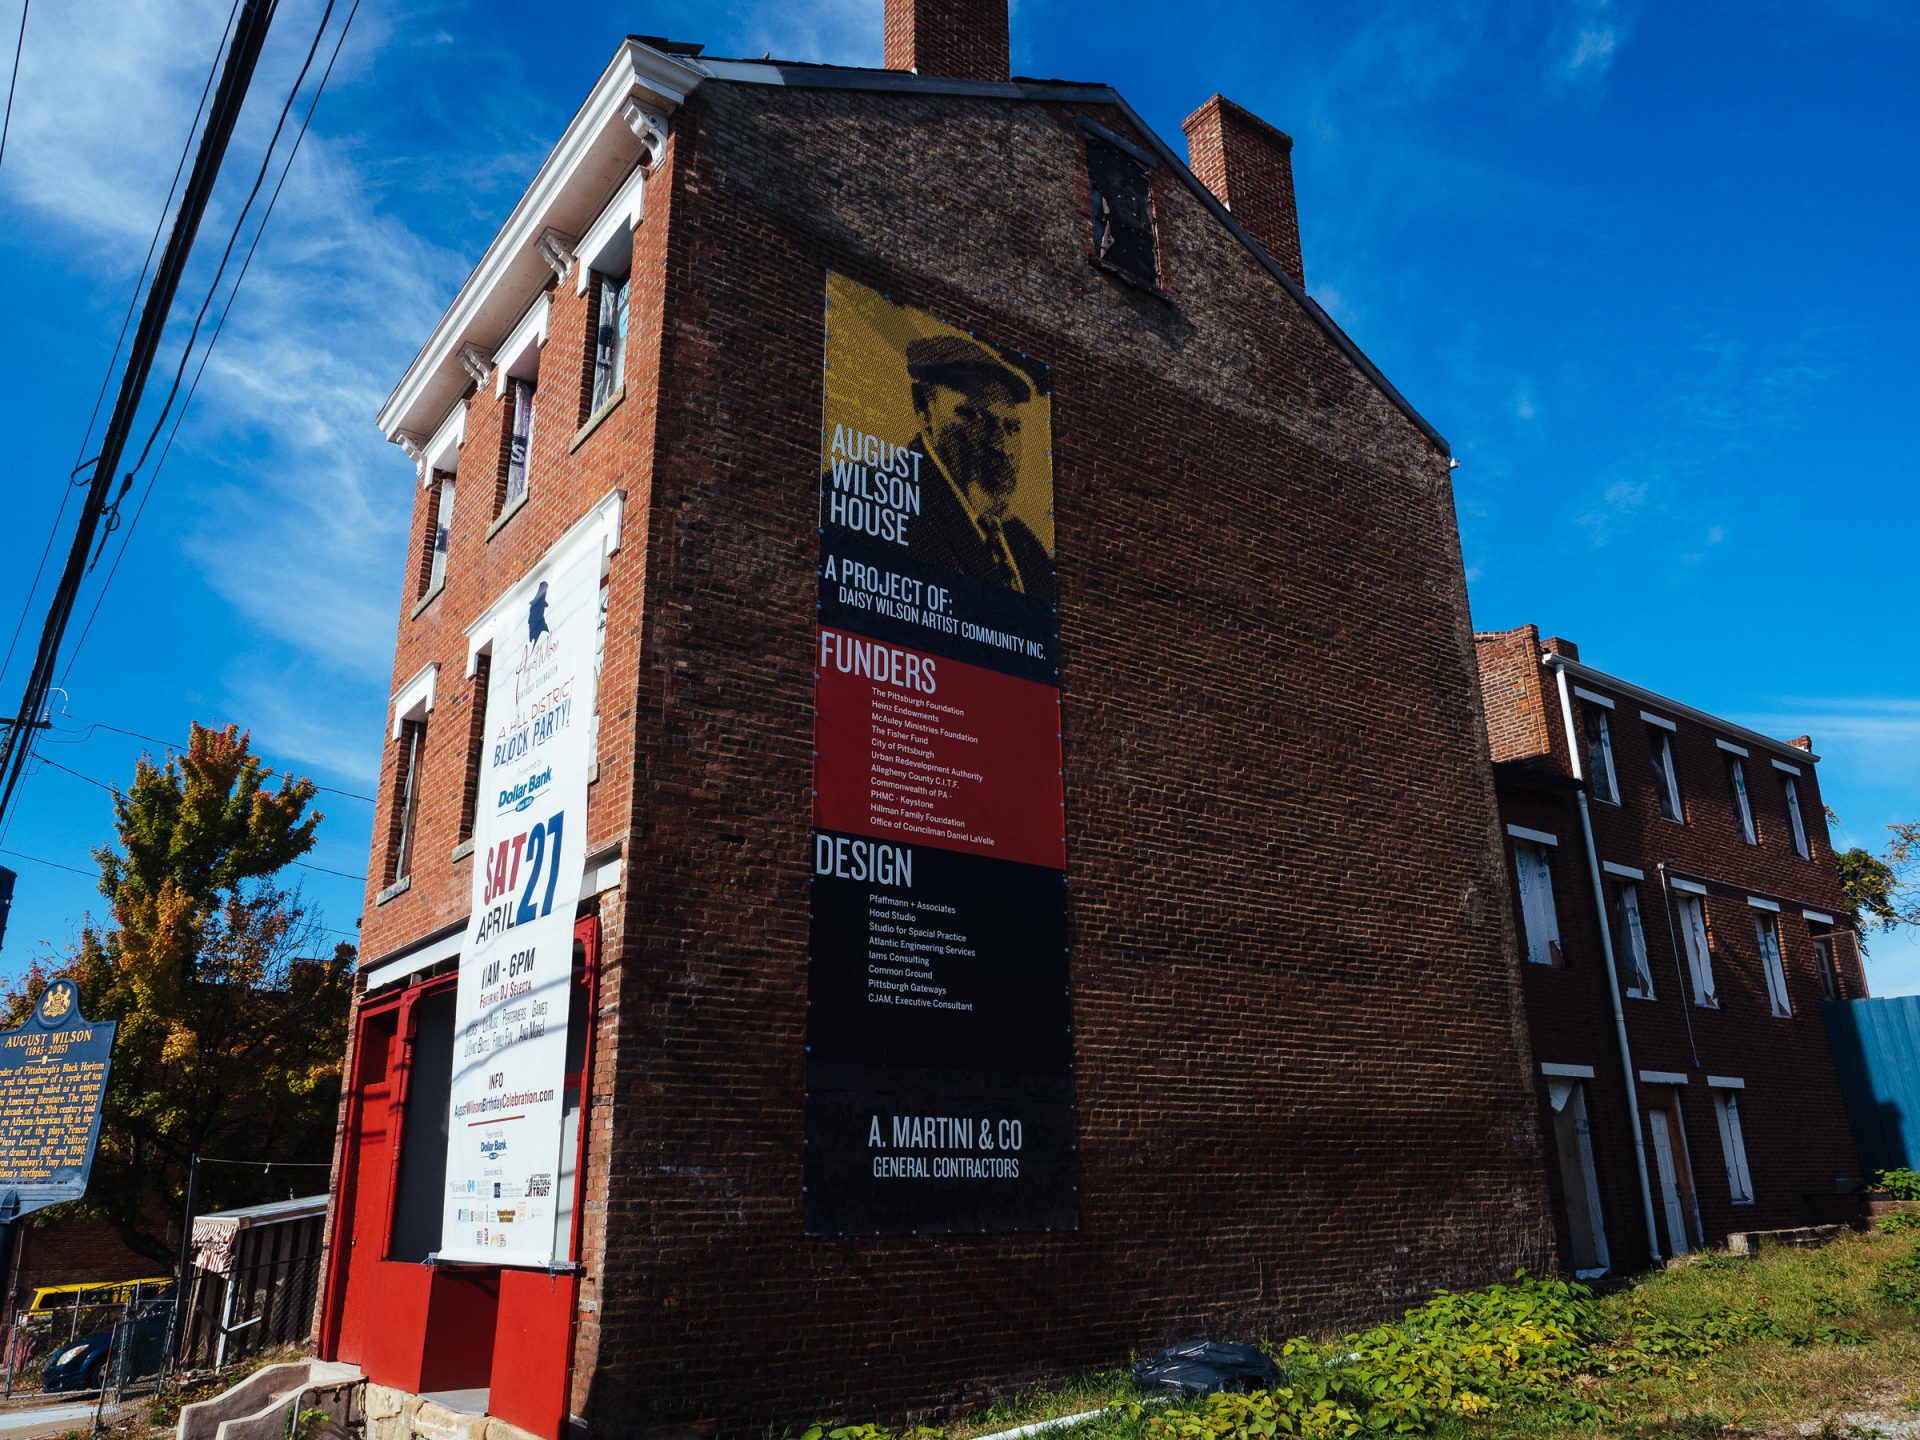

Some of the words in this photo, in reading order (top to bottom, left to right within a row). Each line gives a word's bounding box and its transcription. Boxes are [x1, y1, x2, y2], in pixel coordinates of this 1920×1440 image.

[831, 424, 921, 480] AUGUST
[831, 456, 919, 514] WILSON
[830, 491, 908, 545] HOUSE
[824, 554, 836, 581] A
[842, 559, 922, 604] PROJECT
[927, 584, 952, 614] OF:
[839, 586, 872, 609] DAISY
[875, 596, 918, 623] WILSON
[921, 610, 958, 634] ARTIST
[961, 621, 1024, 652] COMMUNITY
[1026, 640, 1045, 659] INC.
[821, 632, 935, 693] FUNDERS
[497, 727, 506, 740] A
[531, 675, 575, 720] DISTRICT
[871, 686, 886, 697] The
[887, 690, 924, 707] Pittsburgh
[925, 700, 964, 715] Foundation
[871, 699, 892, 711] Heinz
[893, 705, 939, 722] Endowments
[493, 727, 529, 768] BLOCK
[532, 698, 572, 747] PARTY!
[871, 712, 902, 727] McAuley
[904, 720, 938, 734] Ministries
[939, 728, 978, 743] Foundation
[871, 724, 886, 735] The
[887, 728, 909, 739] Fisher
[910, 733, 928, 744] Fund
[871, 737, 886, 749] City
[897, 743, 934, 759] Pittsburgh
[871, 750, 893, 762] Urban
[895, 755, 949, 774] Redevelopment
[951, 768, 982, 782] Authority
[871, 764, 907, 779] Allegheny
[908, 771, 934, 784] County
[935, 776, 959, 788] C.I.T.F.
[497, 783, 528, 808] Dollar
[528, 765, 552, 793] Bank
[870, 776, 927, 794] Commonwealth
[937, 789, 947, 798] PA
[870, 789, 894, 801] PHMC
[900, 795, 933, 808] Keystone
[870, 803, 899, 815] Hillman
[900, 808, 924, 821] Family
[925, 813, 965, 827] Foundation
[870, 816, 892, 827] Office
[893, 821, 901, 829] of
[902, 822, 945, 836] Councilman
[946, 829, 968, 840] Daniel
[969, 834, 994, 845] LaVelle
[484, 832, 528, 906] SAT
[517, 810, 564, 926] 27
[816, 835, 911, 886] DESIGN
[869, 894, 908, 907] Pfaffmann
[916, 901, 955, 913] Associates
[475, 901, 518, 944] APRIL
[869, 908, 889, 918] Hood
[891, 910, 916, 922] Studio
[869, 921, 894, 932] Studio
[895, 925, 907, 934] for
[908, 927, 935, 937] Spacial
[936, 930, 966, 942] Practice
[868, 936, 898, 947] Atlantic
[900, 939, 944, 954] Engineering
[945, 945, 975, 956] Services
[481, 960, 500, 990] 11AM
[509, 947, 536, 978] 6PM
[868, 950, 887, 960] Iams
[889, 952, 929, 966] Consulting
[868, 964, 903, 975] Common
[904, 968, 932, 979] Ground
[500, 983, 509, 1001] DJ
[509, 980, 532, 997] SELECTA
[868, 978, 908, 992] Pittsburgh
[910, 983, 946, 995] Gateways
[531, 999, 548, 1018] GAMES
[868, 993, 893, 1004] CJAM,
[895, 995, 931, 1007] Executive
[932, 999, 972, 1010] Consultant
[5, 1033, 48, 1048] AUGUST
[52, 1030, 93, 1045] WILSON
[4, 1078, 15, 1087] and
[17, 1077, 27, 1086] the
[29, 1076, 48, 1085] author
[50, 1074, 58, 1083] of
[66, 1074, 82, 1085] cycle
[83, 1072, 91, 1081] of
[93, 1073, 103, 1081] ten
[15, 1066, 23, 1076] of
[24, 1065, 60, 1077] Pittsburgh's
[62, 1062, 78, 1073] Black
[81, 1062, 105, 1072] Horizon
[8, 1087, 23, 1096] have
[25, 1086, 39, 1095] been
[42, 1084, 60, 1094] hailed
[79, 1082, 100, 1093] unique
[489, 1072, 504, 1090] INFO
[4, 1106, 23, 1116] decade
[25, 1106, 33, 1115] of
[33, 1106, 42, 1115] the
[44, 1104, 57, 1114] 20th
[60, 1105, 82, 1115] century
[84, 1103, 96, 1112] and
[6, 1096, 34, 1107] American
[37, 1095, 65, 1105] literature.
[68, 1093, 79, 1102] The
[81, 1092, 98, 1104] plays
[1, 1119, 9, 1127] on
[10, 1117, 33, 1126] African
[33, 1115, 61, 1125] American
[63, 1114, 73, 1124] life
[75, 1114, 81, 1123] in
[83, 1113, 93, 1123] the
[9, 1126, 21, 1136] Two
[24, 1126, 32, 1136] of
[35, 1126, 45, 1135] the
[47, 1138, 59, 1146] won
[63, 1135, 88, 1146] Pulitzer
[868, 1115, 886, 1147] A.
[893, 1116, 972, 1148] MARTINI
[978, 1118, 994, 1149] &
[998, 1119, 1022, 1150] CO
[9, 1149, 27, 1157] drama
[30, 1147, 36, 1156] in
[40, 1146, 54, 1156] 1987
[55, 1146, 68, 1156] and
[480, 1141, 494, 1152] Dollar
[494, 1139, 507, 1151] Bank
[11, 1157, 43, 1170] Broadway's
[45, 1156, 60, 1169] Tony
[61, 1156, 83, 1167] Award.
[20, 1167, 52, 1179] birthplace.
[873, 1156, 929, 1177] GENERAL
[933, 1157, 1018, 1177] CONTRACTORS
[532, 1186, 551, 1198] TRUST
